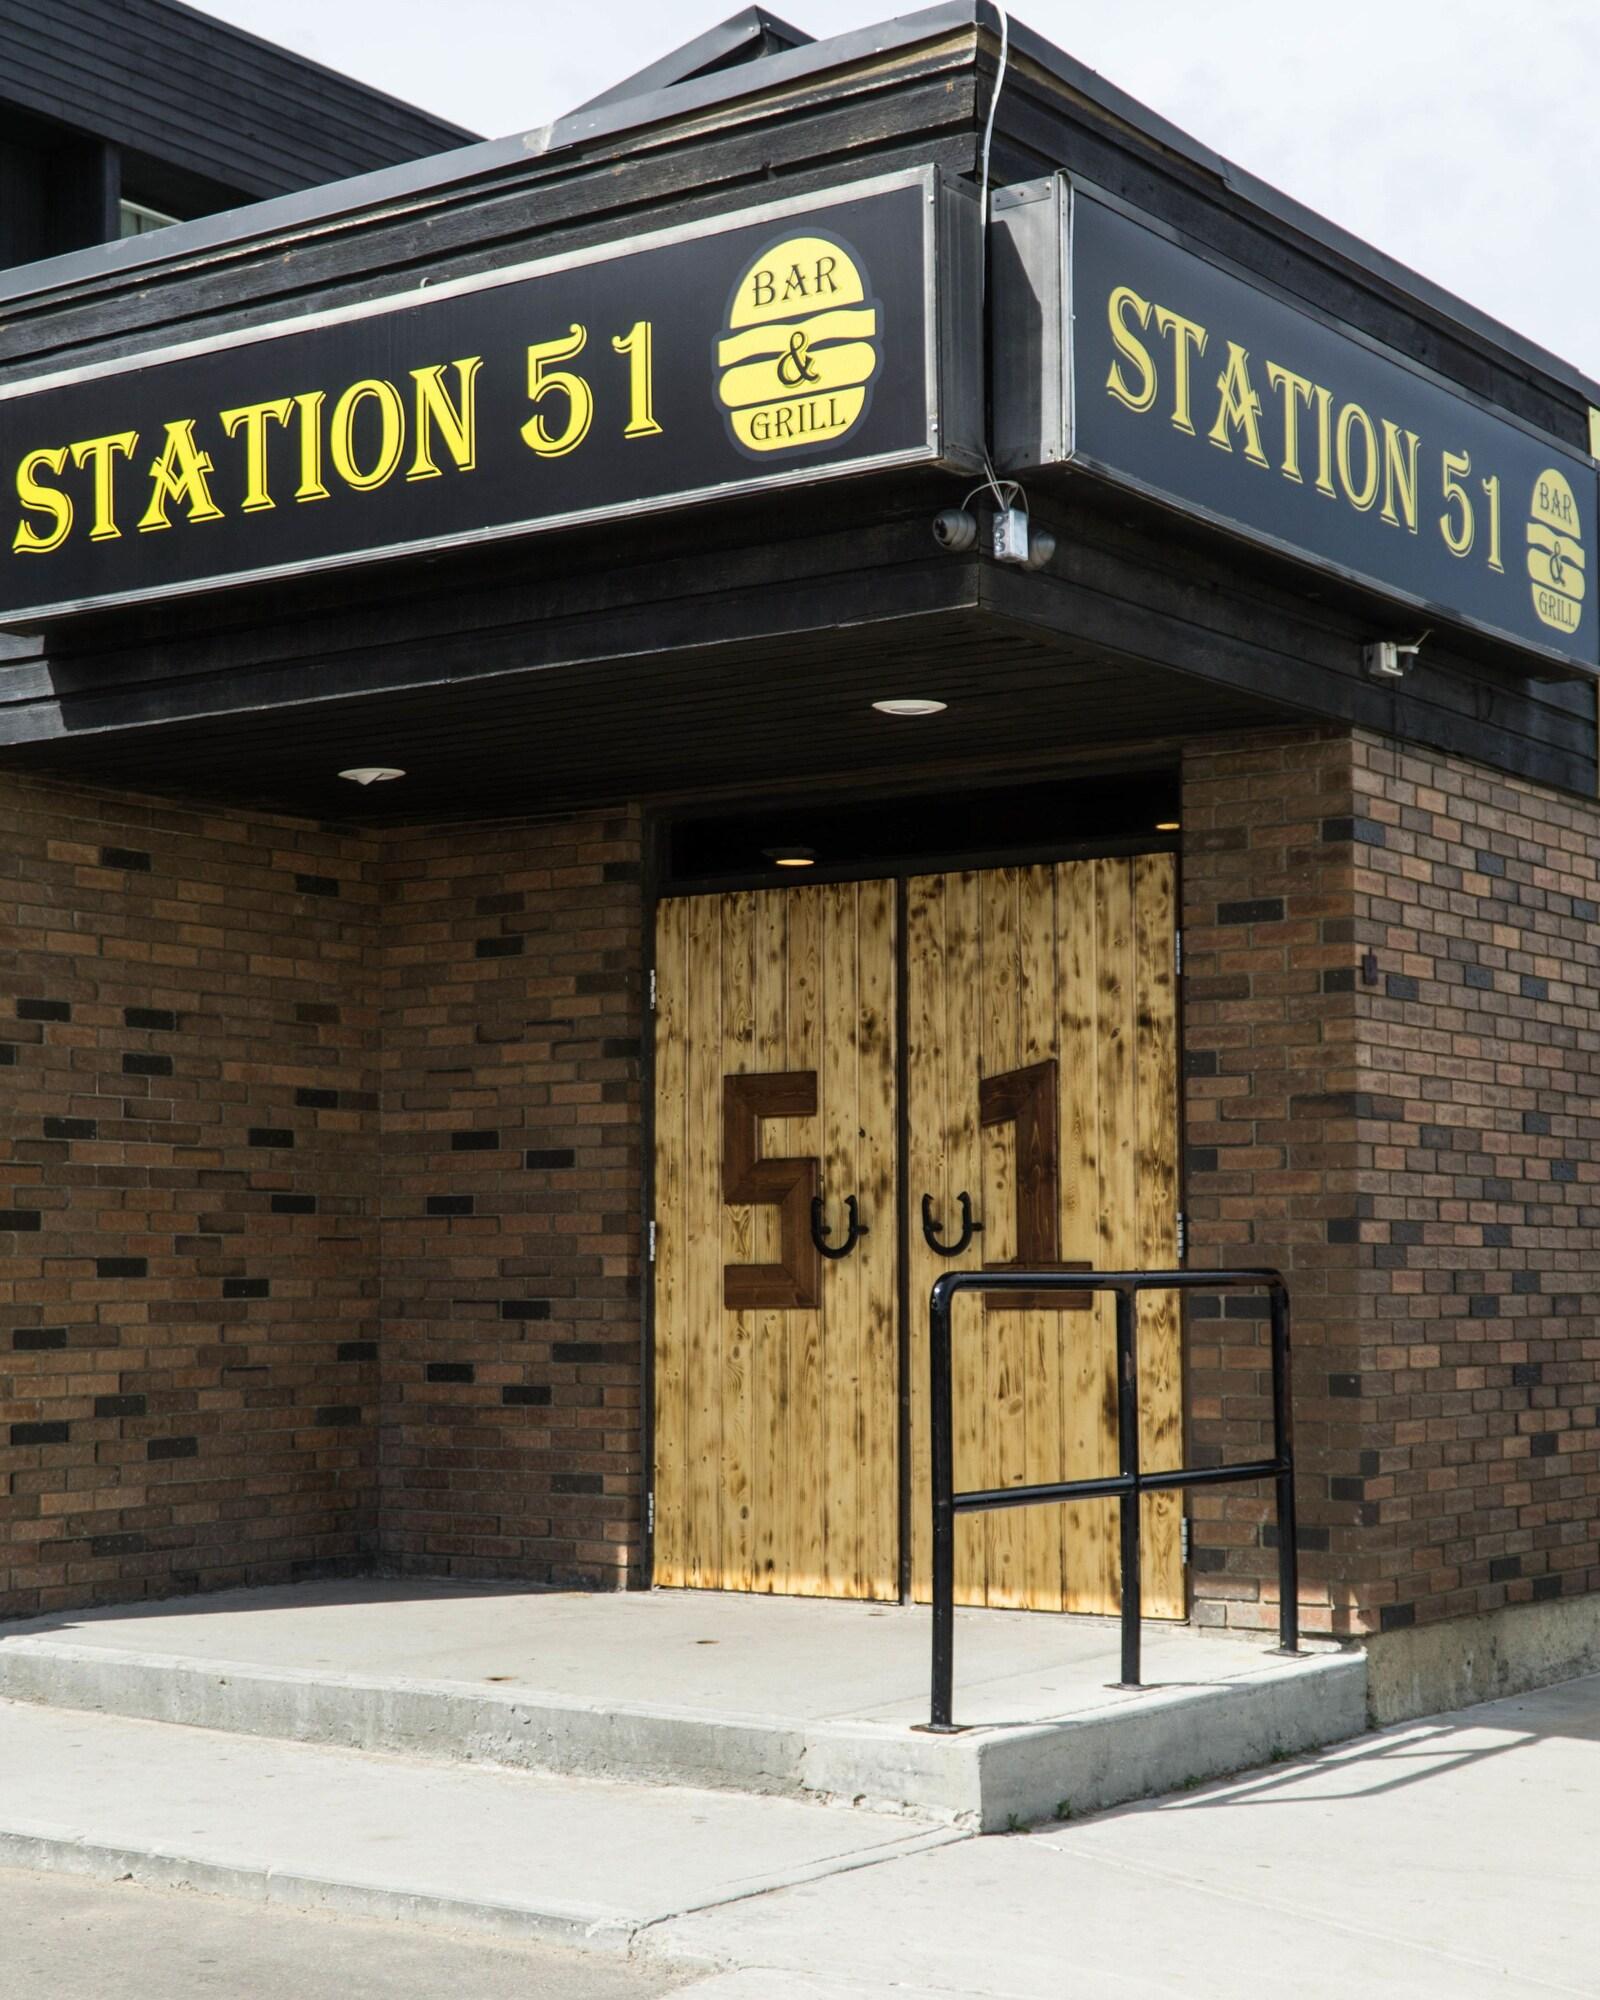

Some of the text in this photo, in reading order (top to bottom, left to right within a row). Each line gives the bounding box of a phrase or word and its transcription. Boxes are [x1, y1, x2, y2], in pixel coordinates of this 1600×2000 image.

[753, 255, 839, 309] BAR
[777, 331, 819, 387] &
[11, 321, 663, 555] STATION 51
[750, 397, 848, 442] GRILL
[1106, 286, 1504, 573] STATION 51
[1540, 482, 1572, 524] BAR
[1549, 541, 1565, 587] &
[1539, 592, 1575, 627] GRILL
